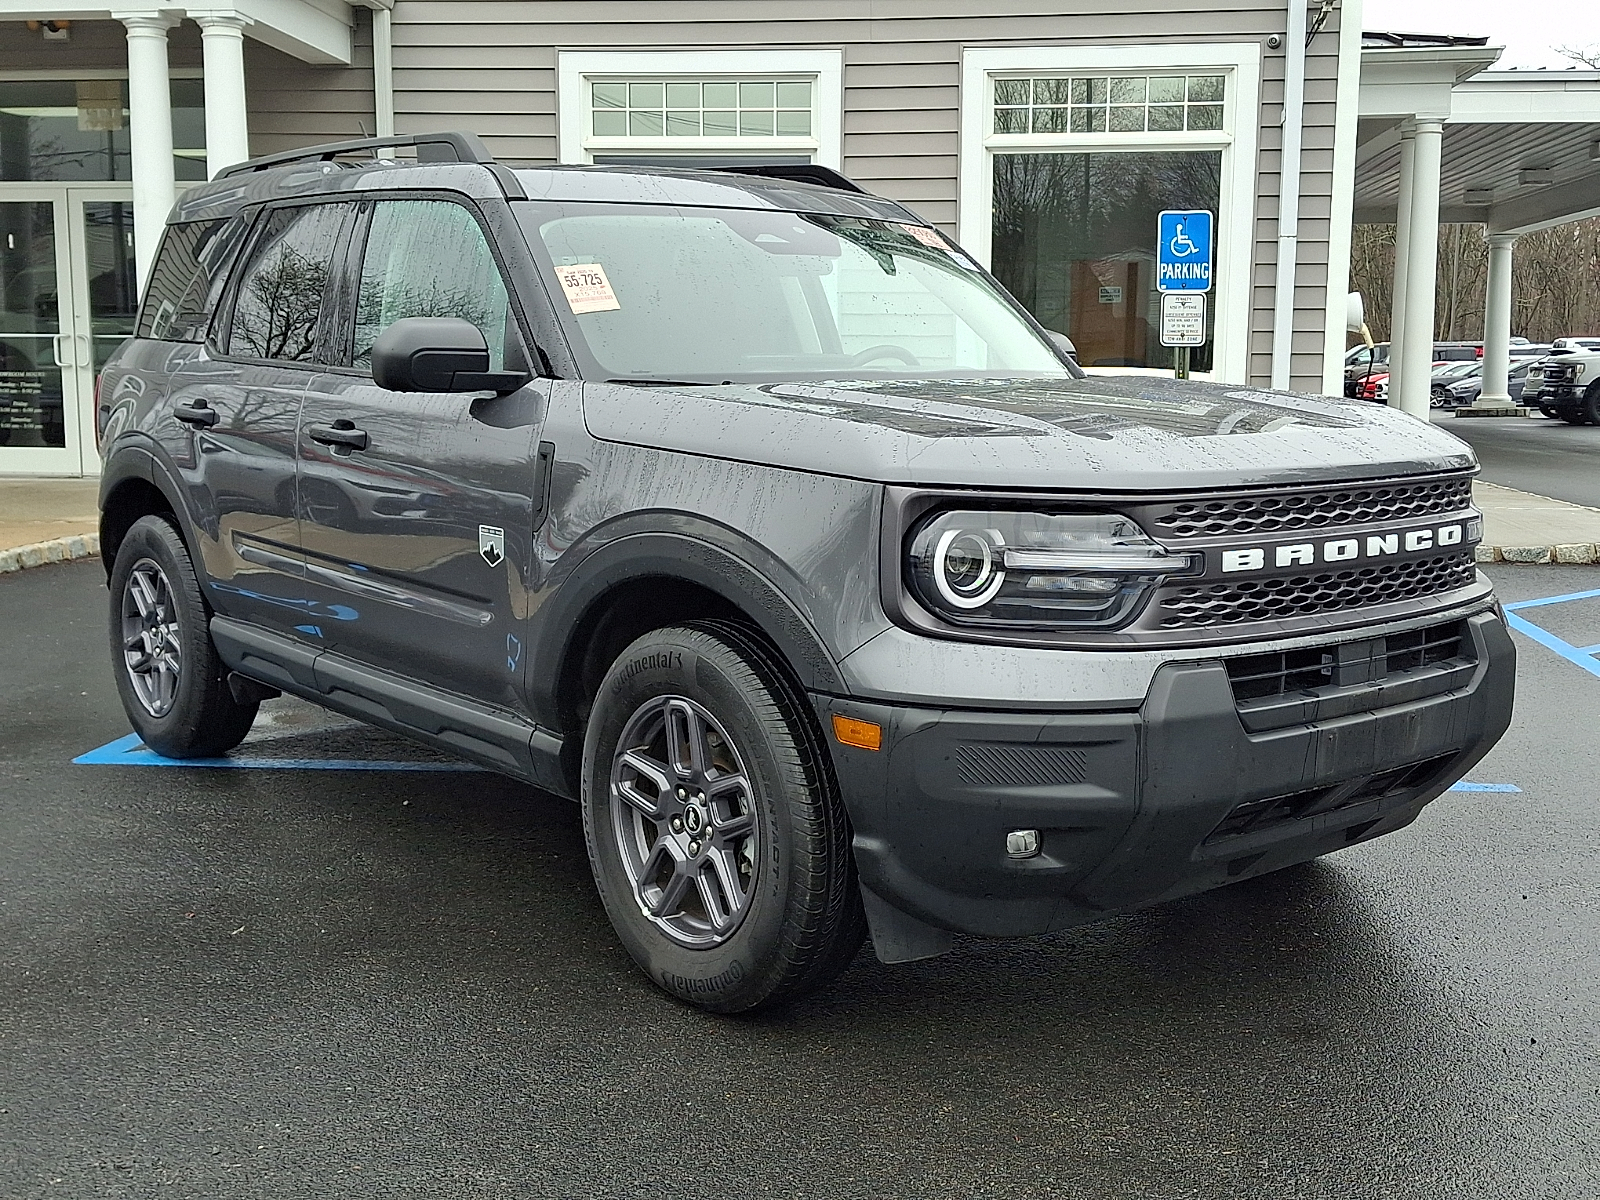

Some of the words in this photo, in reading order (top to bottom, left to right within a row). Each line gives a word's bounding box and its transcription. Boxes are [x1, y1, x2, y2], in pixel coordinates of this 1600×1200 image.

[1160, 262, 1209, 279] PARKING
[1222, 525, 1462, 573] BRONCO
[611, 650, 674, 695] Continental
